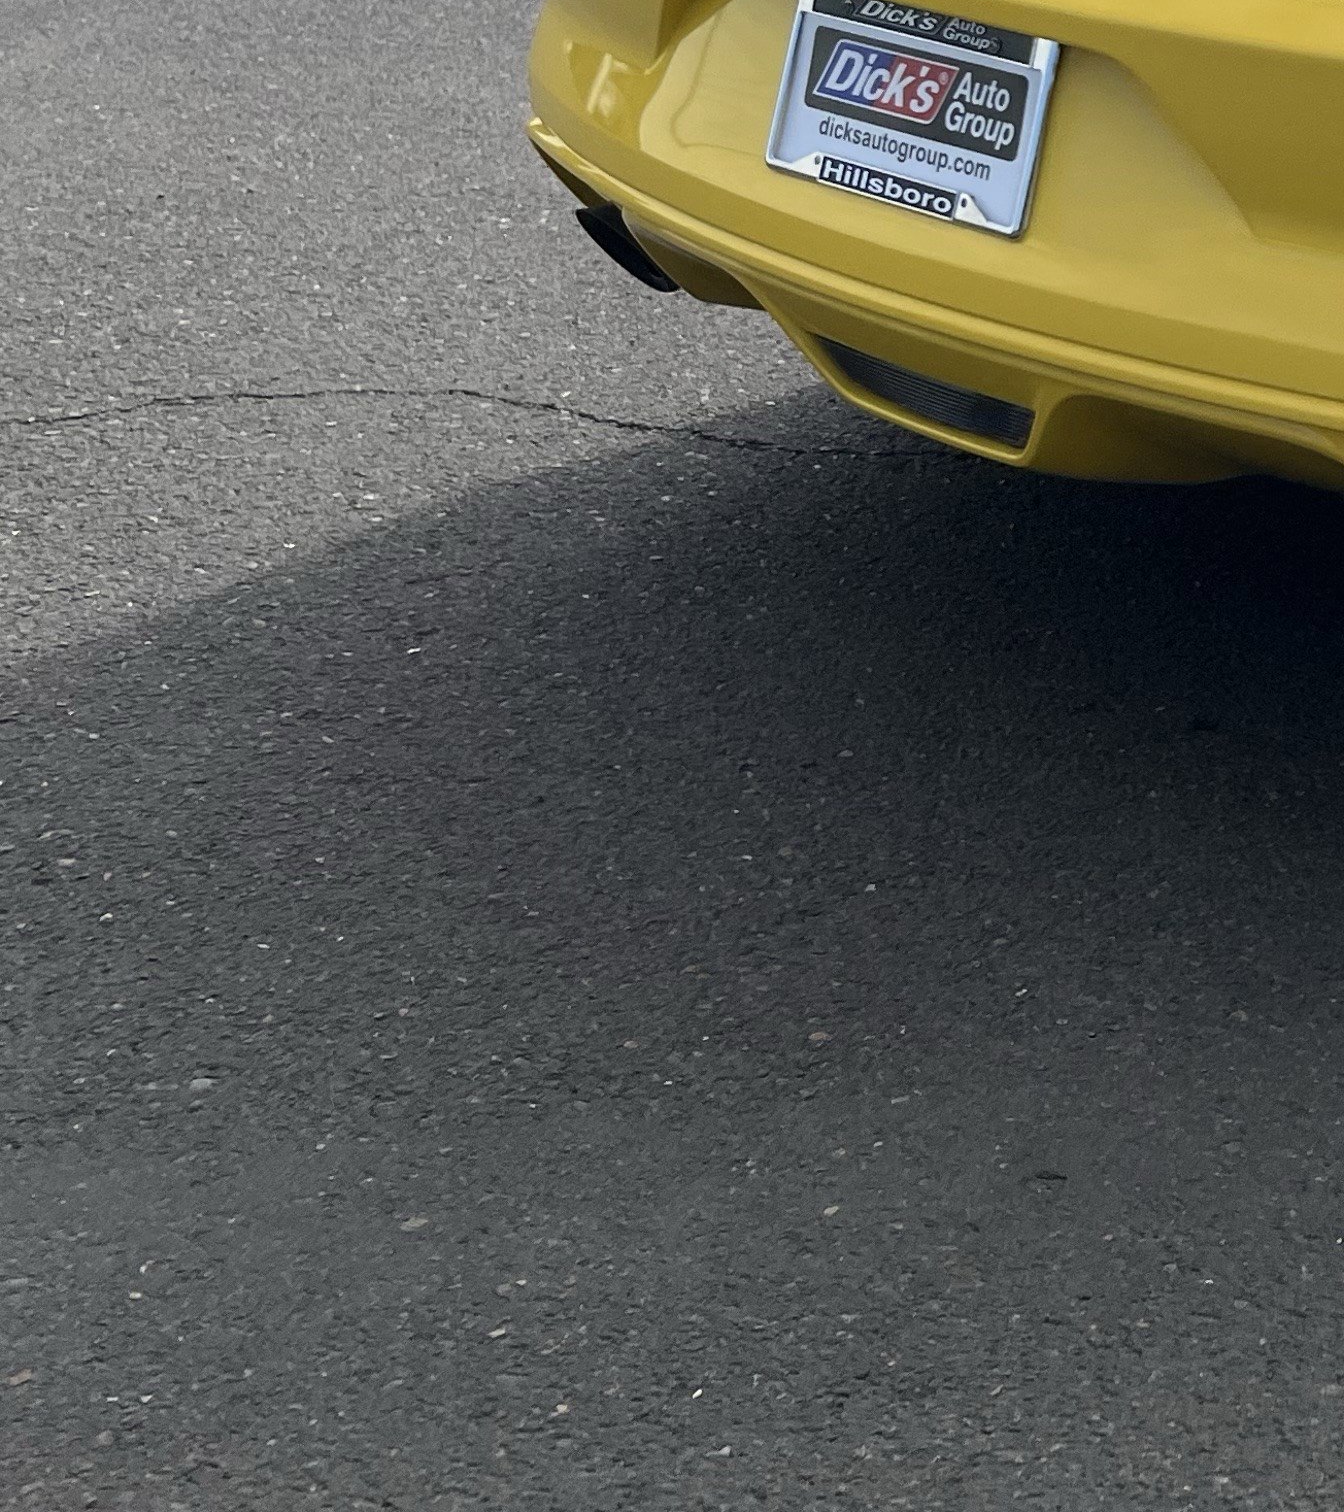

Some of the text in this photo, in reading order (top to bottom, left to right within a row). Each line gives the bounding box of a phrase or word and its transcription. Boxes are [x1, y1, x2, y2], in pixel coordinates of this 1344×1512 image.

[860, 0, 938, 31] Dick's
[950, 17, 986, 35] Auto
[943, 27, 991, 50] Group
[825, 48, 940, 114] Dick's
[952, 72, 1011, 112] Auto
[945, 101, 1015, 150] Group
[818, 117, 992, 181] dicksautogroup.com
[821, 160, 952, 214] Hillsboro
